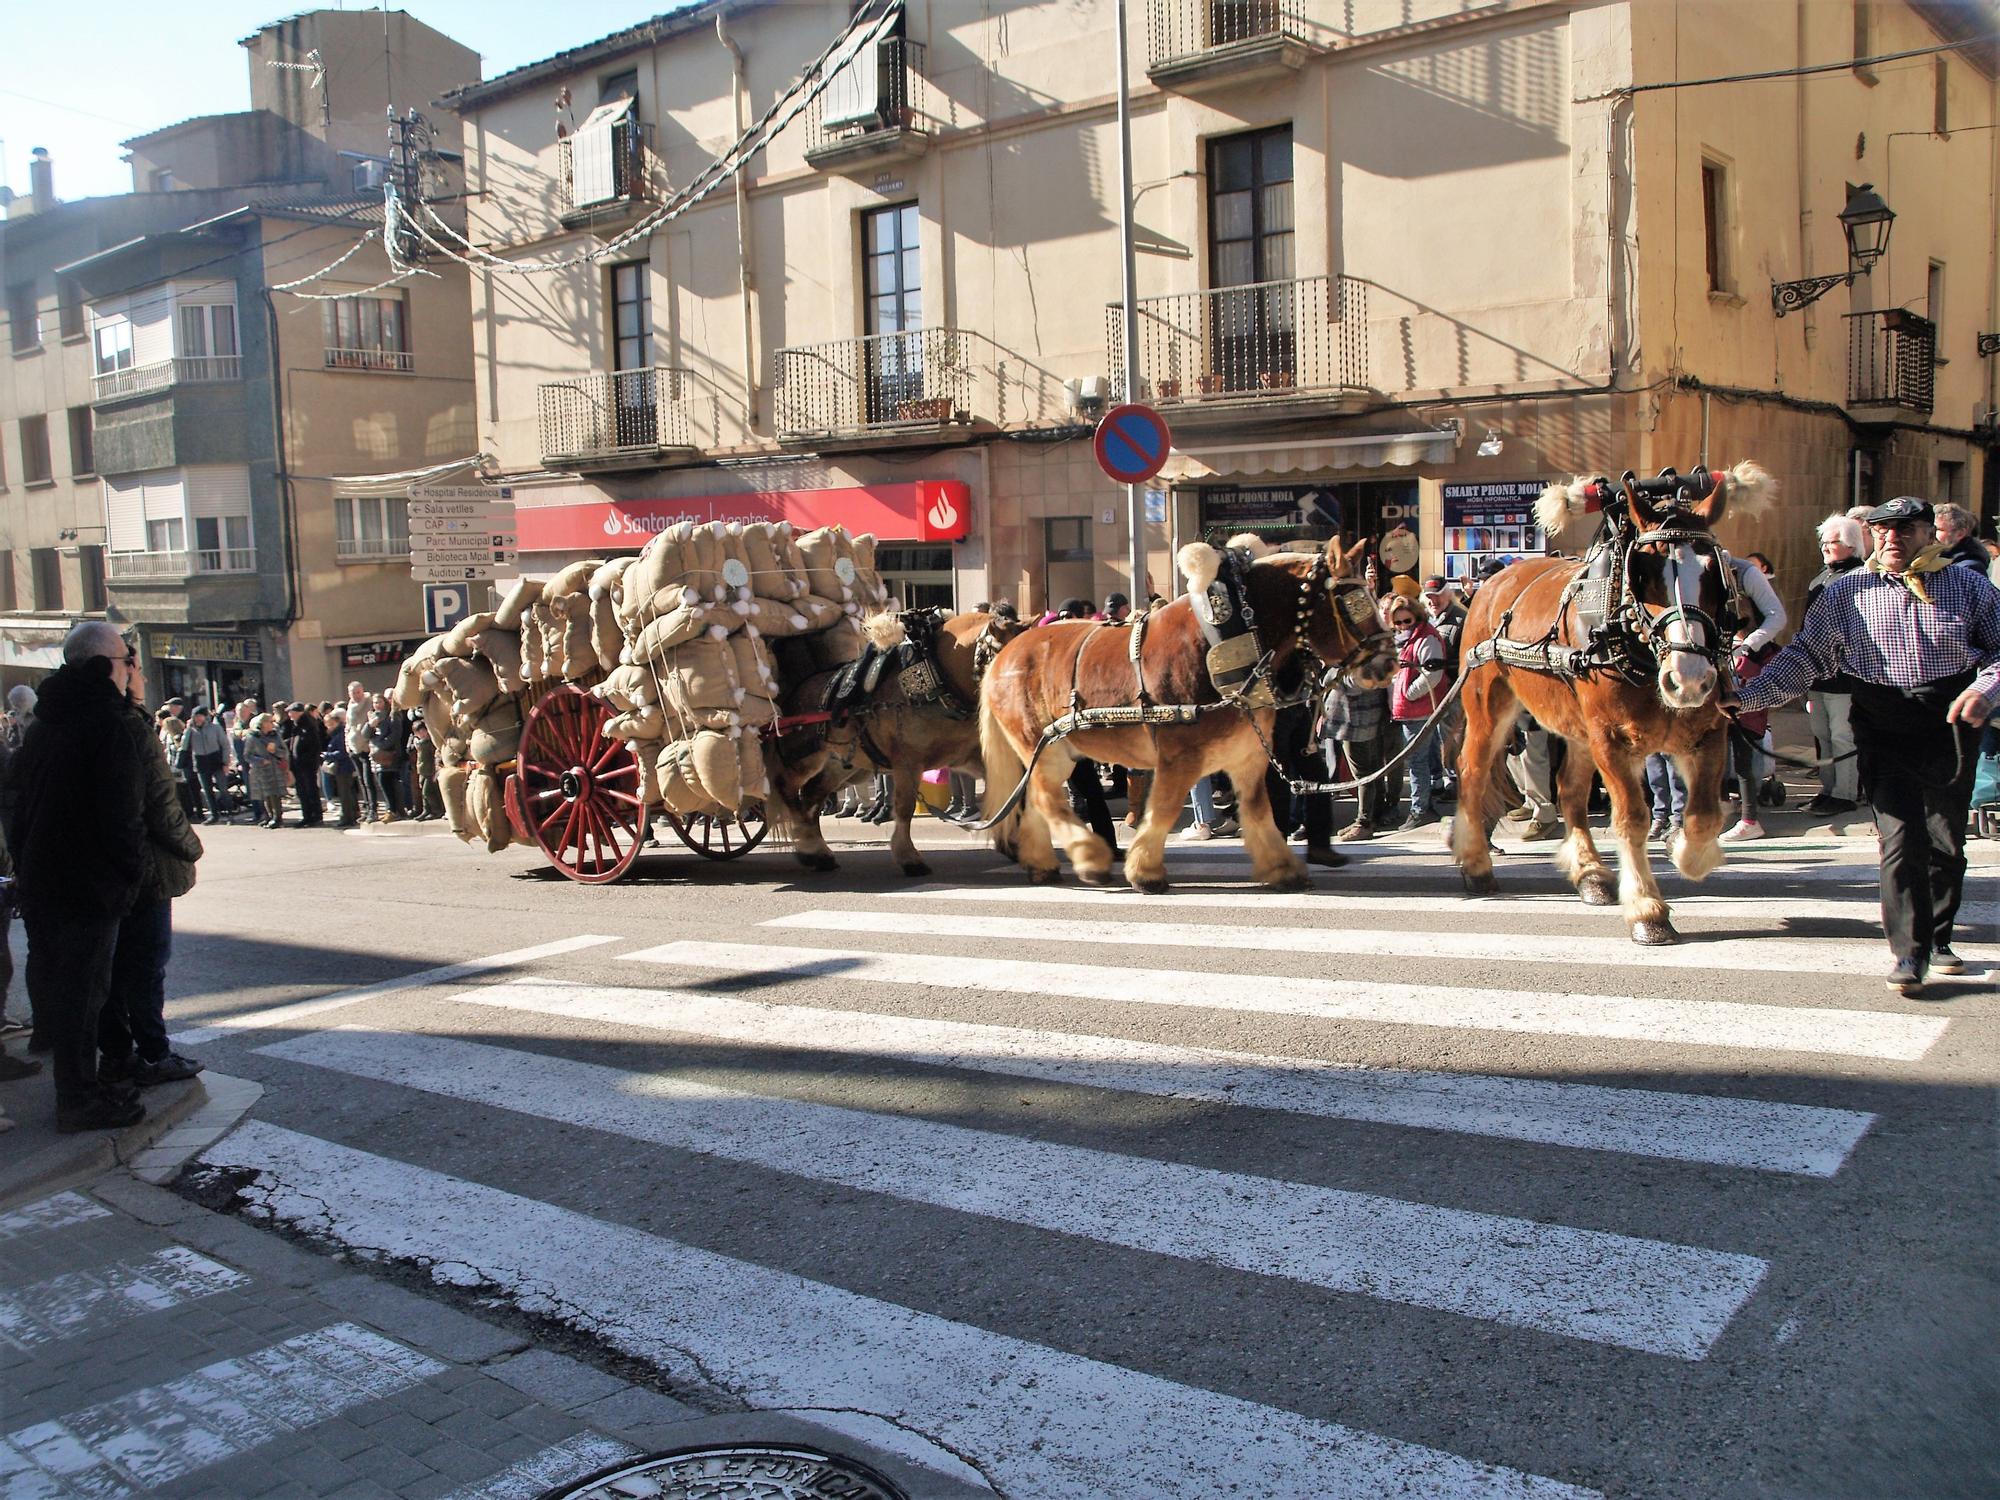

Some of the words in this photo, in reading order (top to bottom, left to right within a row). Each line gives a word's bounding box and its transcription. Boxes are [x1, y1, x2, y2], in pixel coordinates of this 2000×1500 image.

[424, 488, 456, 498] Hospital
[1446, 485, 1480, 498] SMART
[1482, 484, 1516, 496] PHONE
[1207, 493, 1237, 504] SMART
[1240, 491, 1269, 503] PHONE
[424, 504, 443, 514] Sala
[425, 520, 444, 530] CAP
[426, 537, 446, 546] Parc
[449, 536, 490, 547] Municipal
[427, 552, 467, 562] Biblioteca
[470, 552, 491, 563] Mpal.
[428, 568, 462, 577] Auditori
[433, 589, 461, 628] P
[173, 639, 245, 660] SUPERMERCAT
[362, 654, 376, 664] GR
